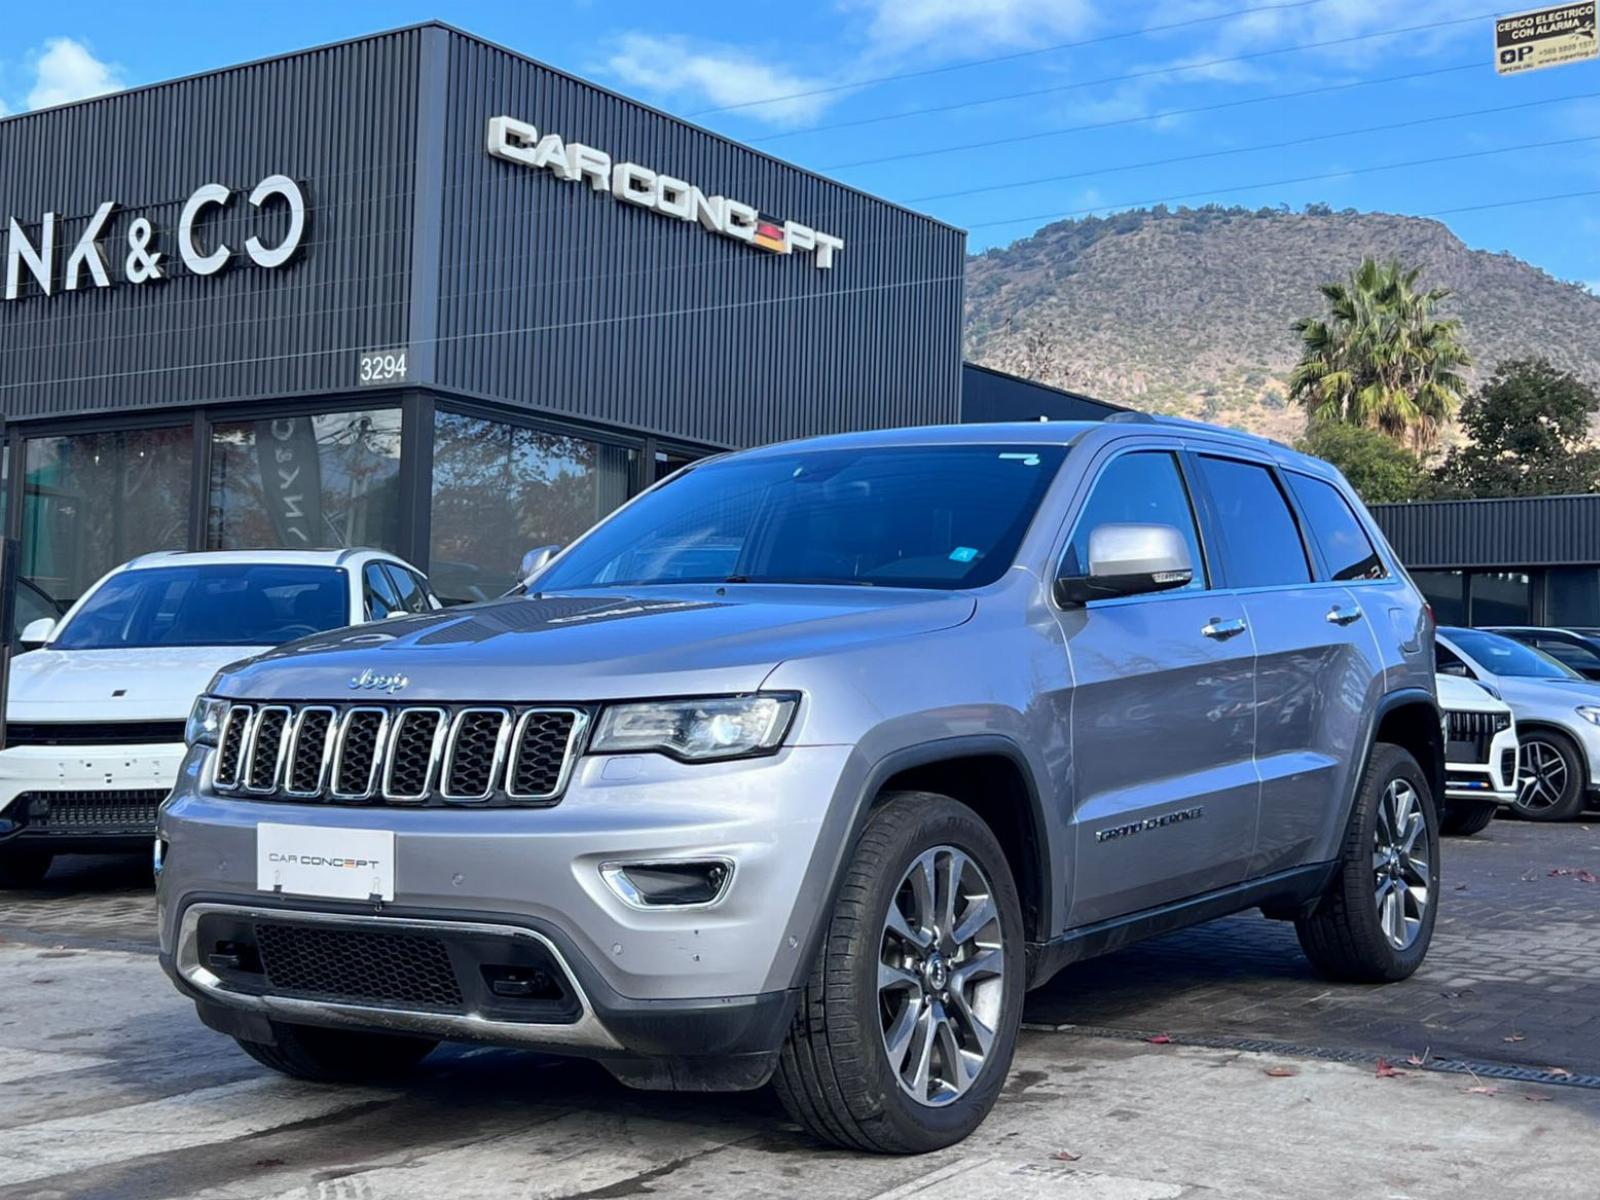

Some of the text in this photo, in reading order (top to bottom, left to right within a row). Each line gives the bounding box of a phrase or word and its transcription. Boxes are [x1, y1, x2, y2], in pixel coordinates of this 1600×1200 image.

[1497, 6, 1594, 32] CERCO ELECTRICO
[1511, 18, 1580, 39] CON ALARMA
[1500, 46, 1534, 65] OP
[488, 115, 844, 269] CAR CONCEPT
[361, 353, 407, 381] 3294
[347, 668, 408, 695] Jeep
[268, 853, 380, 869] CAR CONCEPT
